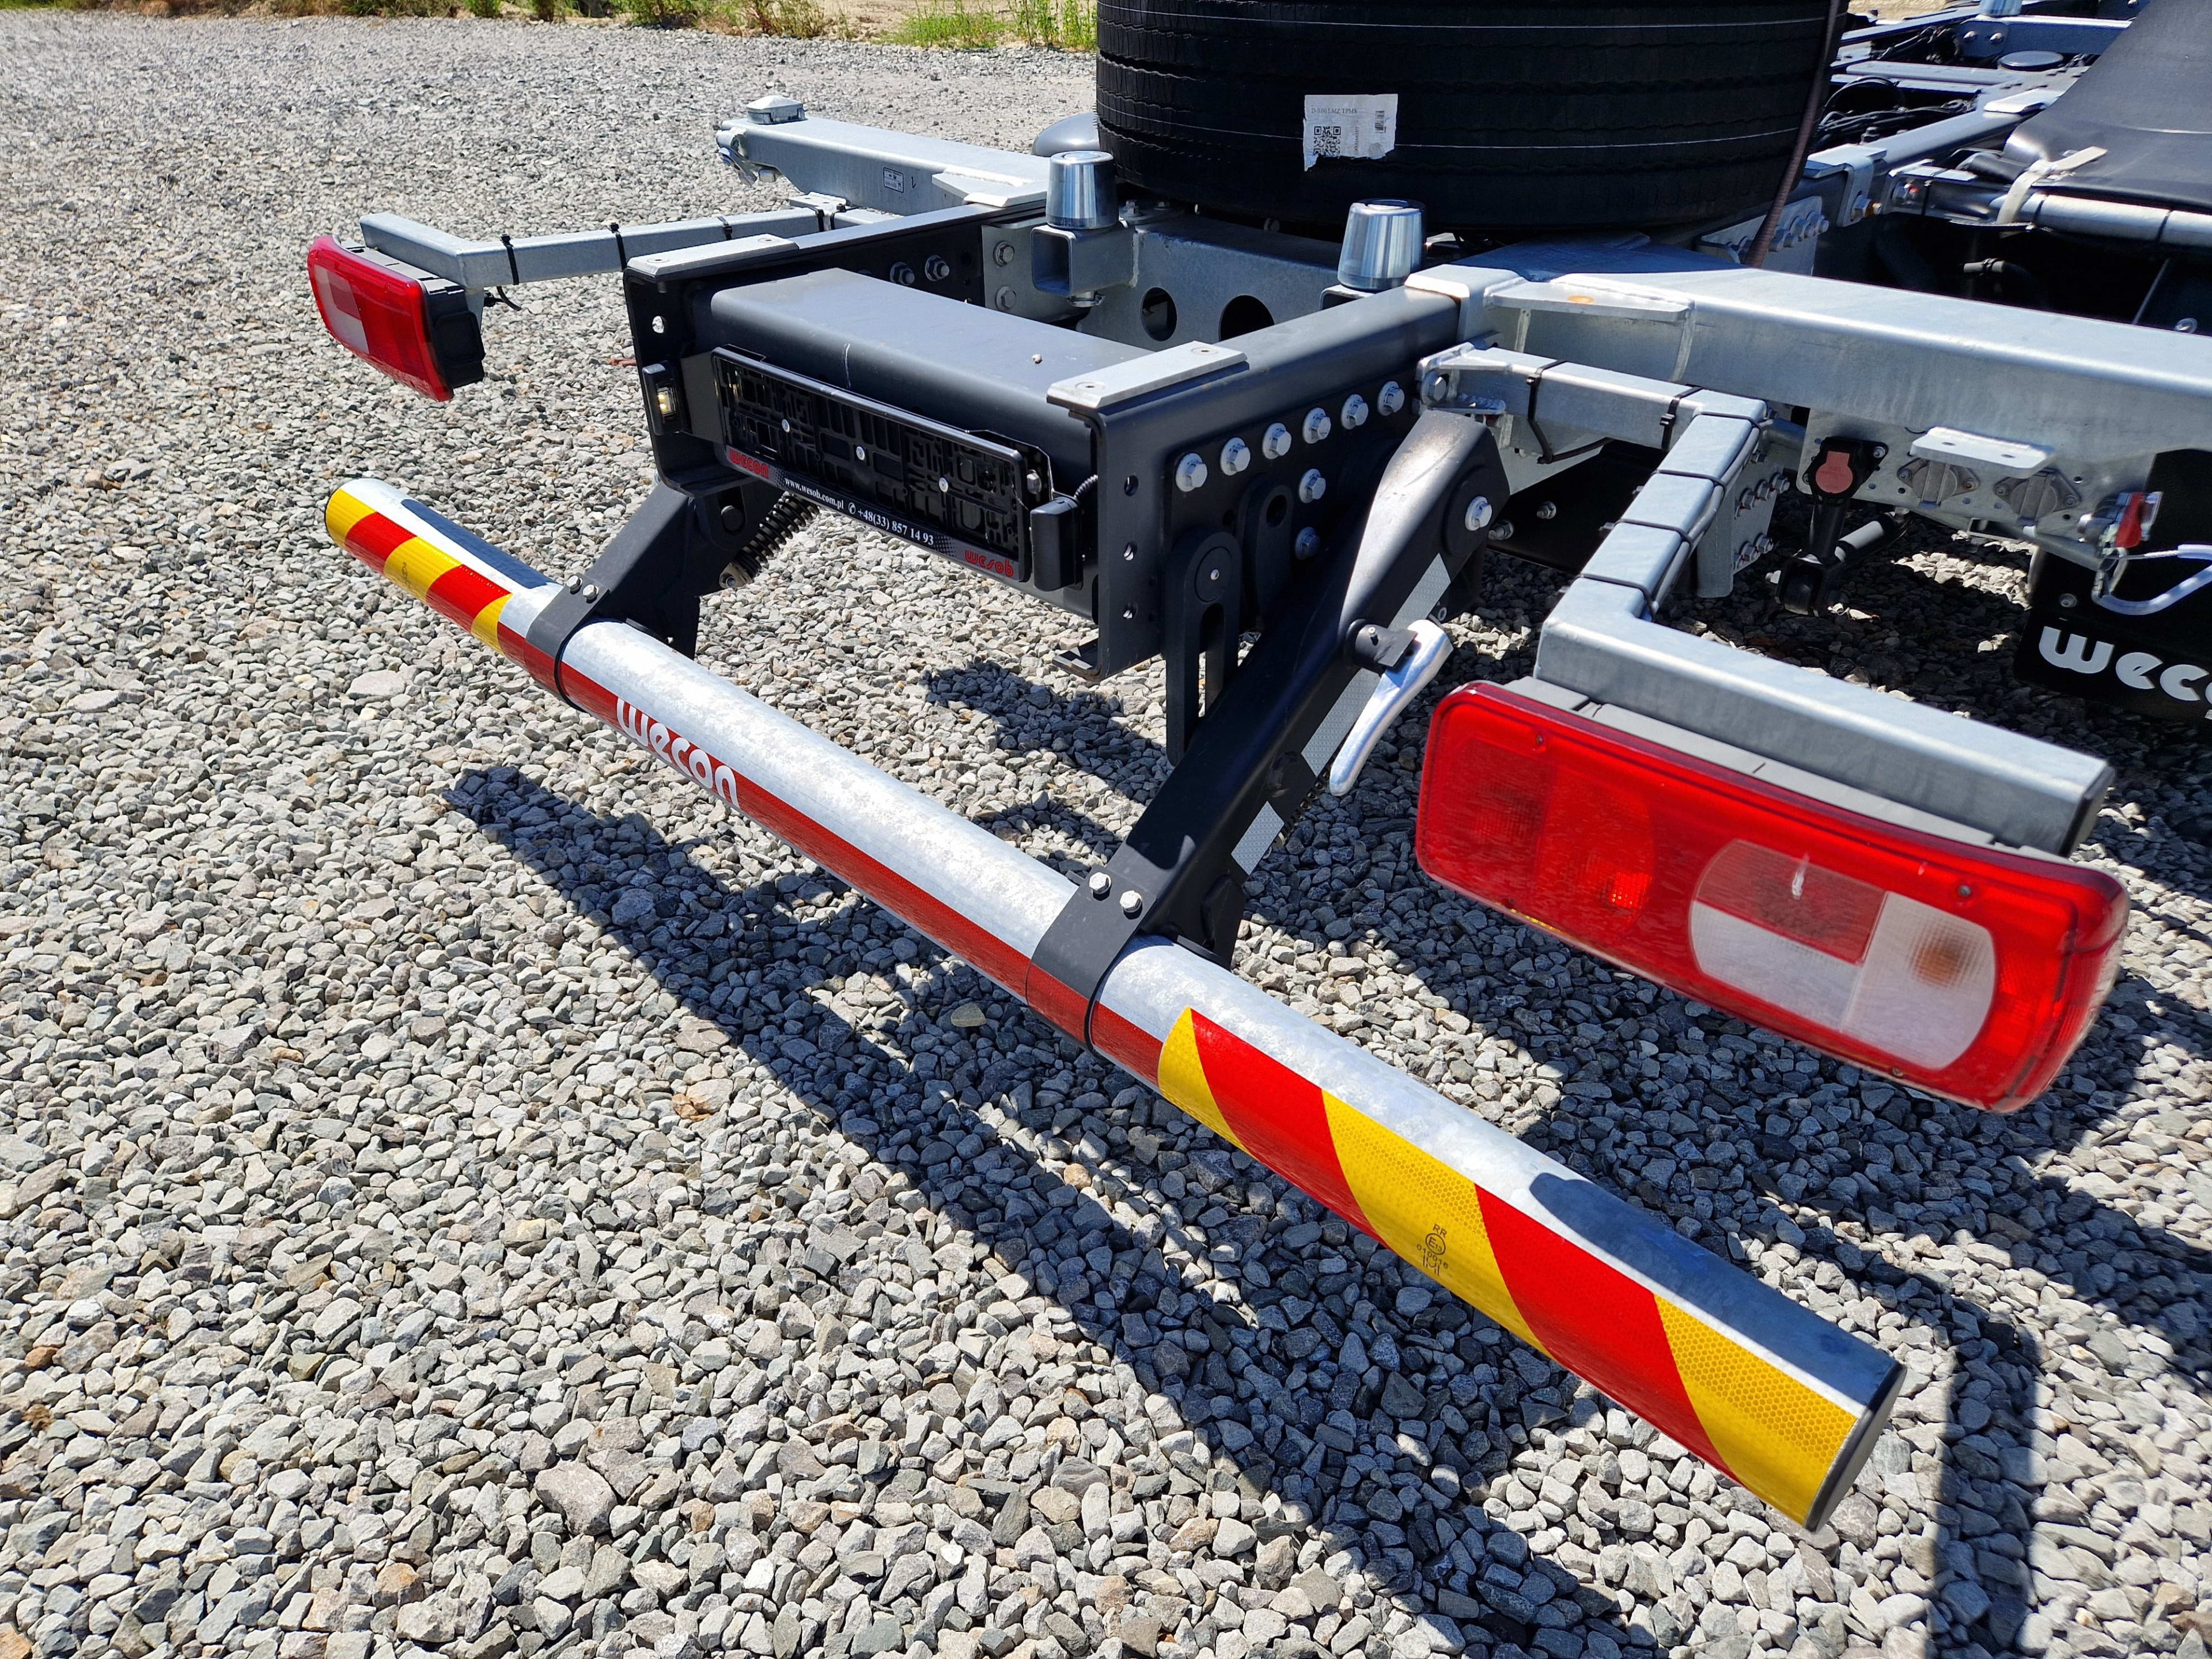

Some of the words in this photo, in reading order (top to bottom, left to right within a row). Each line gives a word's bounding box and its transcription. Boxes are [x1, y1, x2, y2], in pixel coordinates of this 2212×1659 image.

[729, 448, 769, 479] wecon
[785, 477, 844, 509] www.wesob.com.pl
[858, 507, 889, 531] +48(33)
[892, 520, 908, 536] 857
[910, 528, 921, 541] 14
[923, 532, 934, 546] 93
[965, 548, 1014, 578] wesob
[2039, 626, 2212, 704] wec
[616, 696, 740, 808] wecon
[1433, 1224, 1447, 1238] RR
